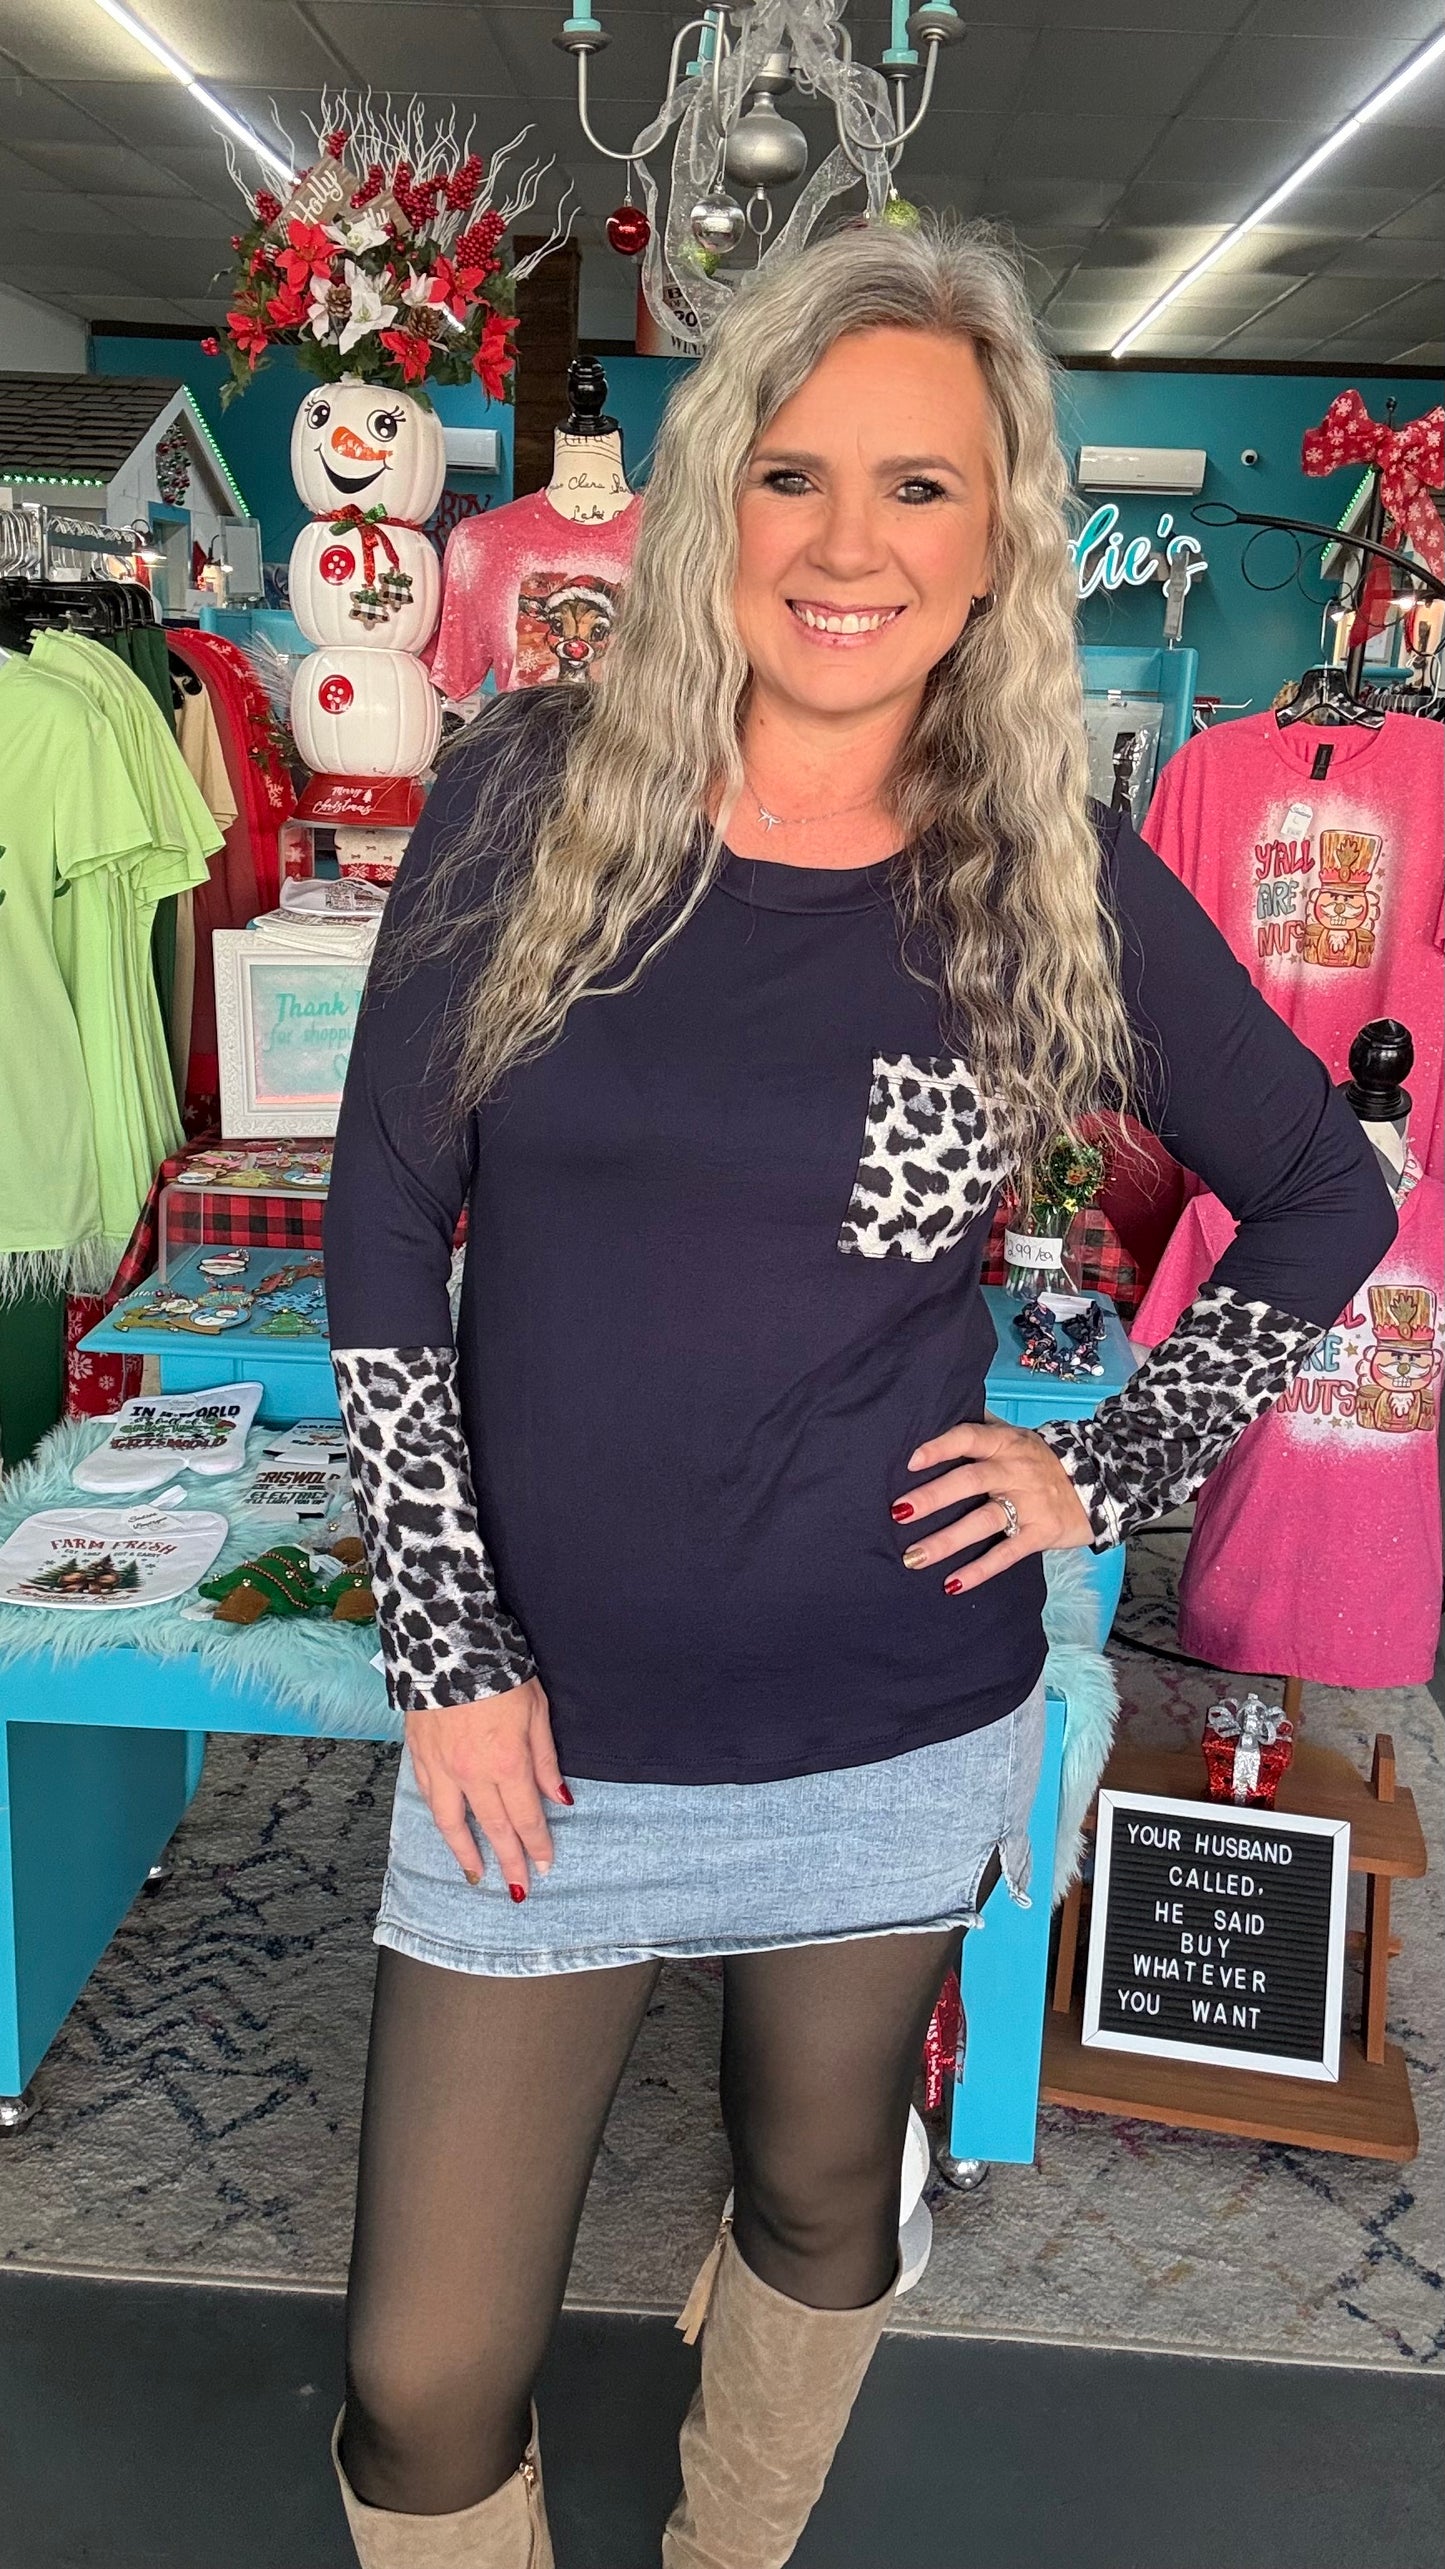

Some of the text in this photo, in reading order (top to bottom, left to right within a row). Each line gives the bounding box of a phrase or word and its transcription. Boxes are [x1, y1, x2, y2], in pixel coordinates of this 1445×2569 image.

[290, 170, 343, 224] Holly
[1067, 503, 1208, 599] lie's
[1254, 839, 1316, 880] Y'ALL
[1257, 880, 1299, 919] ARE
[275, 991, 349, 1022] Thank
[303, 1021, 354, 1050] shoppi
[130, 1406, 156, 1417] IN
[1276, 1376, 1357, 1416] NUTS
[51, 1538, 178, 1556] FARM FRESH
[1127, 1823, 1293, 1865] YOUR HUSBAND
[1155, 1900, 1265, 1936] HE SAID
[1181, 1932, 1231, 1959] BUY
[1133, 1953, 1266, 1994] WHATEVER
[1117, 1989, 1261, 2030] YOU WANT
